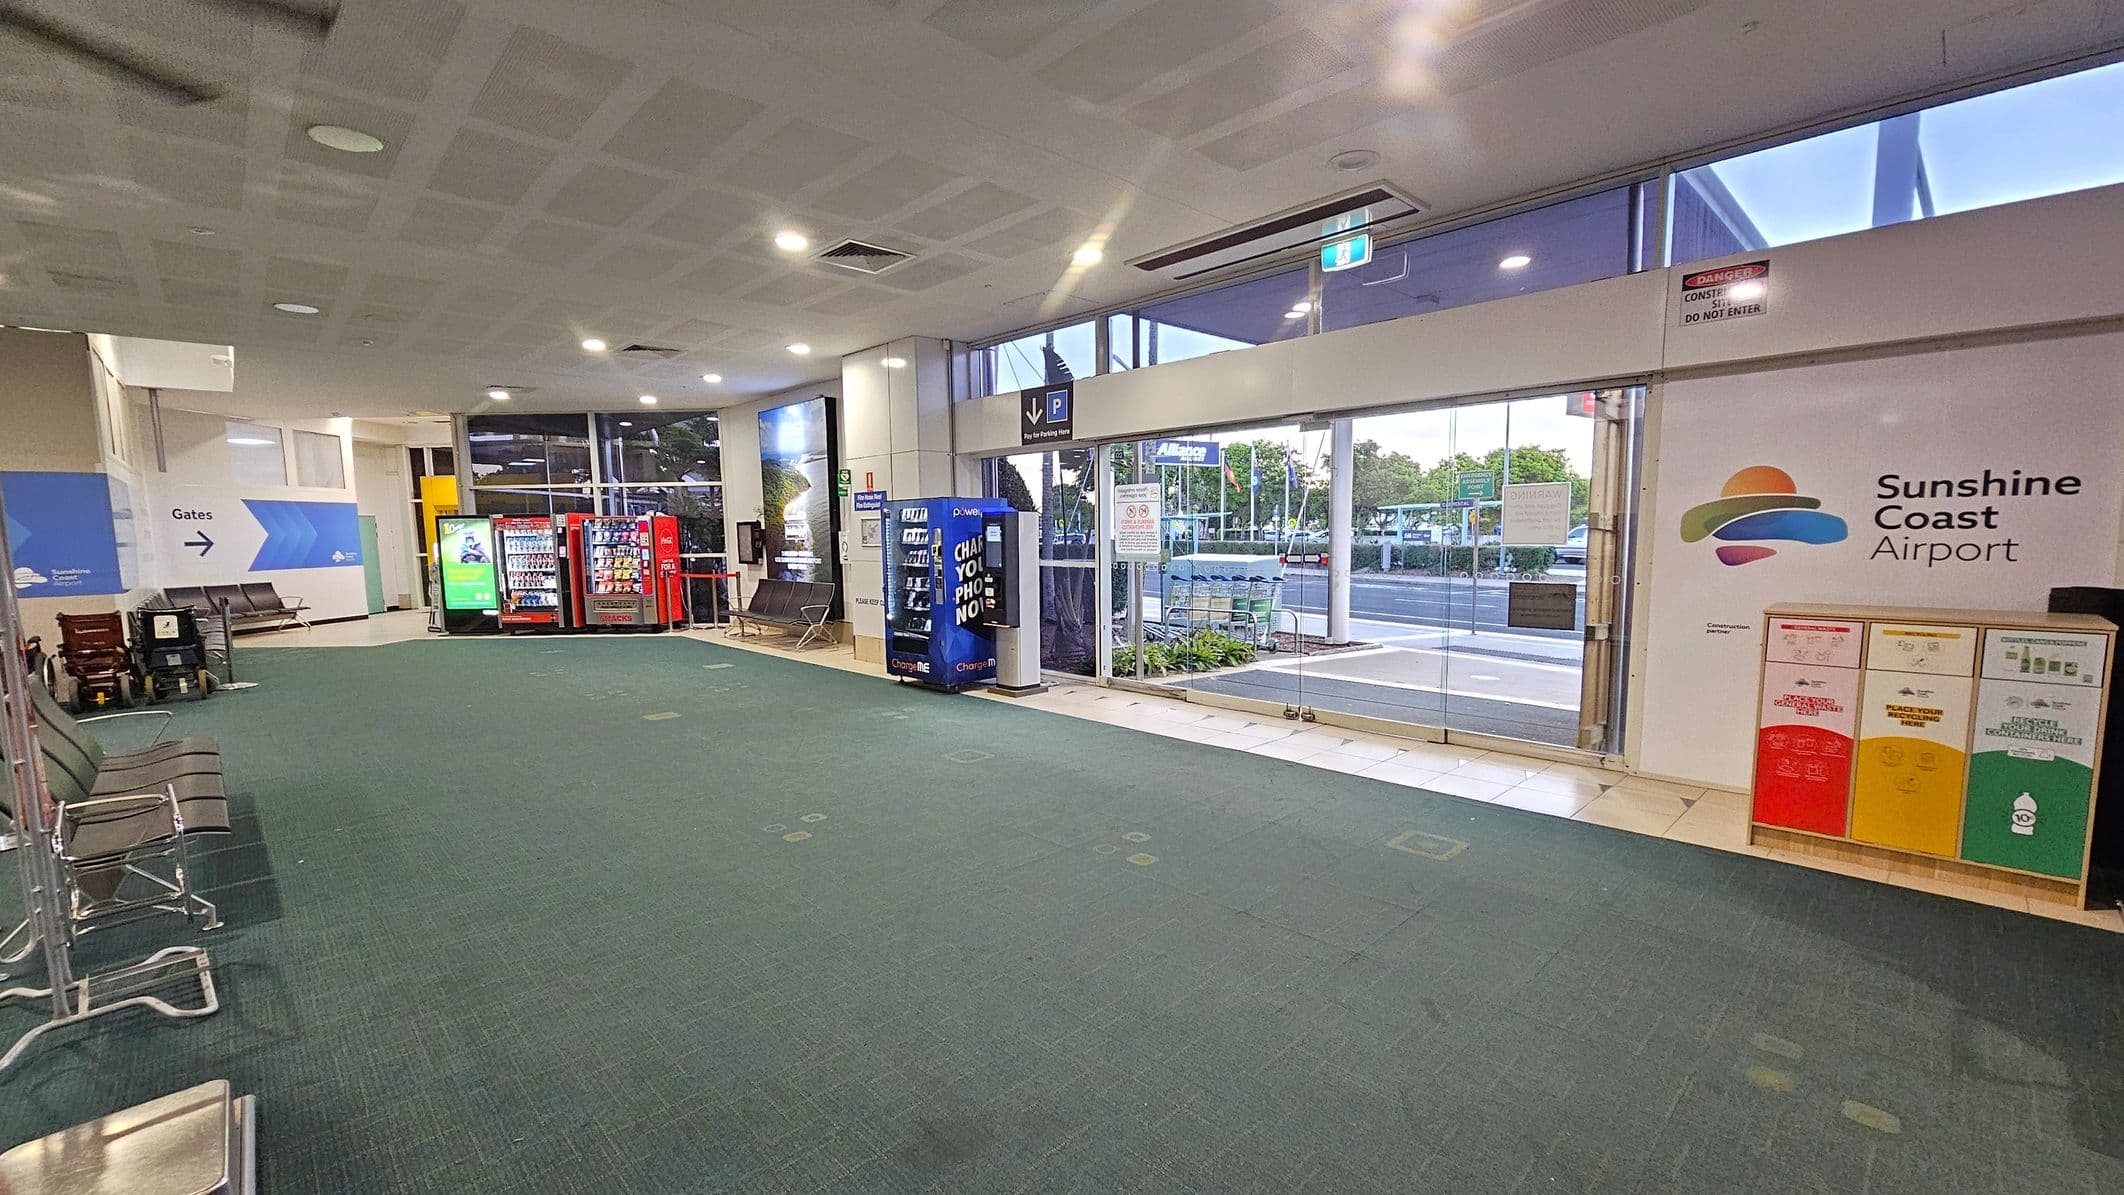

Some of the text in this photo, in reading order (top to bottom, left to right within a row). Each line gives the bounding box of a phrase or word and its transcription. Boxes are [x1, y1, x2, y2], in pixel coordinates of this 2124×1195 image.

[1696, 268, 1753, 285] DANGER
[1684, 287, 1727, 302] CONSTR
[1712, 299, 1731, 308] SIT
[1685, 303, 1761, 323] DO NOT ENTER
[1053, 398, 1062, 415] P
[1040, 430, 1058, 438] Parking
[1157, 442, 1207, 456] Alliance
[1877, 469, 2081, 499] Sunshine
[172, 508, 213, 520] Gates
[1874, 505, 1999, 530] Coast
[1870, 535, 2020, 568] Airport
[892, 659, 930, 673] ChargeME
[1783, 694, 1834, 704] PLACE YOUR
[1796, 708, 1819, 716] HERE
[1886, 703, 1943, 716] PLACE YOUR
[1888, 712, 1941, 722] RECYCLING
[1900, 719, 1925, 728] HERE
[2013, 717, 2057, 727] RECYCLE
[2002, 723, 2067, 736] YOUR DRINK
[1985, 728, 2082, 745] CONTAINERS HERE
